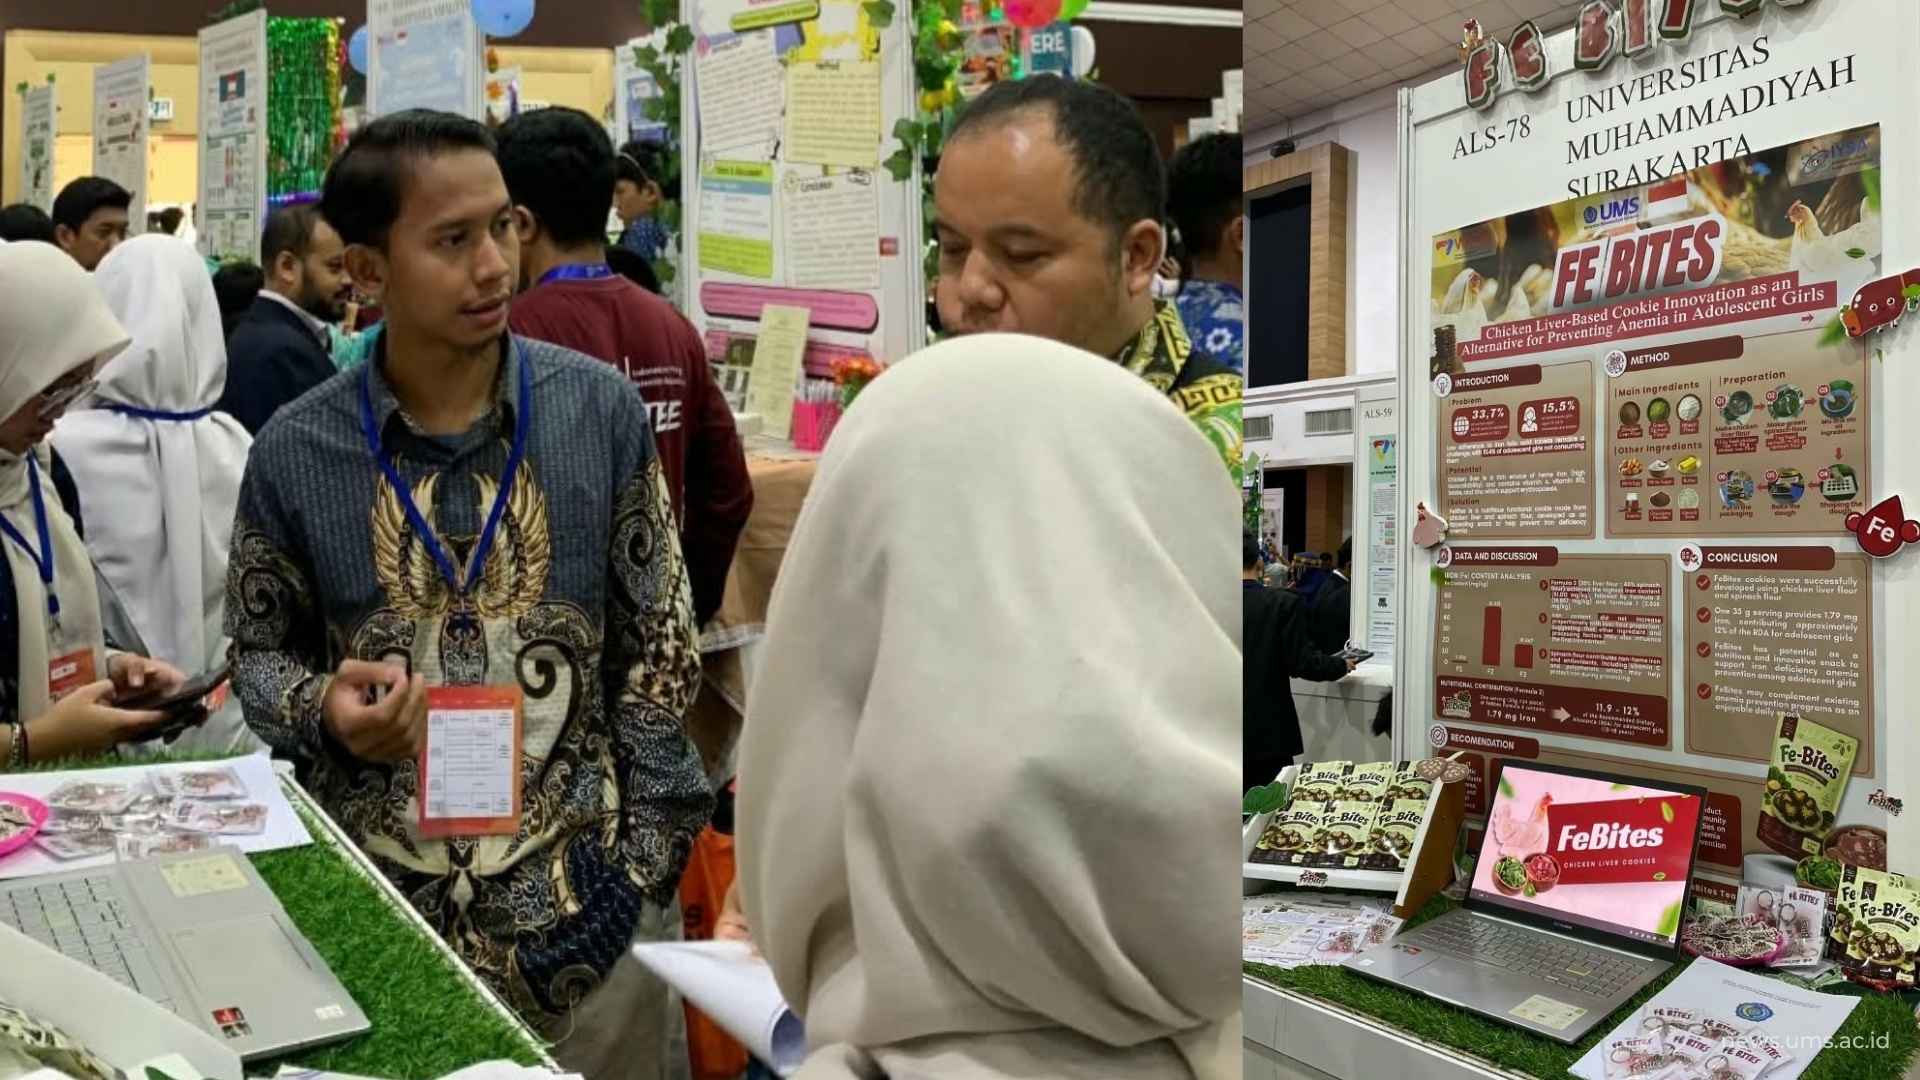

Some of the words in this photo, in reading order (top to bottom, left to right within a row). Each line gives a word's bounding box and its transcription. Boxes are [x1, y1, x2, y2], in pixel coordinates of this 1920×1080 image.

[1465, 20, 1549, 111] FE
[1567, 36, 1771, 123] UNIVERSITAS
[1568, 55, 1856, 165] MUHAMMADIYAH
[1452, 114, 1532, 161] ALS-78
[1568, 133, 1752, 199] SURAKARTA
[1600, 197, 1639, 220] UMS
[1554, 246, 1600, 309] FE
[1603, 220, 1721, 299] BITES
[1486, 326, 1532, 340] Chicken
[1536, 308, 1608, 333] Liver-Based
[1612, 300, 1659, 319] Cookie
[1664, 286, 1745, 311] Innovation
[1751, 283, 1767, 295] as
[1771, 279, 1791, 292] an
[1461, 337, 1523, 356] Alternative
[1526, 333, 1543, 346] for
[1547, 323, 1613, 344] Preventing
[1617, 314, 1669, 332] Anemia
[1673, 311, 1687, 323] in
[1692, 297, 1776, 320] Adolescent
[1782, 287, 1825, 305] Girls
[1631, 352, 1670, 366] METHOD
[1455, 373, 1510, 387] INTRODUCTION
[1723, 371, 1786, 385] Preparation
[1618, 387, 1640, 396] Main
[1452, 397, 1482, 406] Problem
[1618, 446, 1643, 454] Other
[1867, 516, 1895, 542] Fe
[1455, 552, 1473, 560] DATA
[1474, 552, 1489, 560] AND
[1491, 552, 1538, 561] DISCUSSION
[1707, 553, 1778, 564] CONCLUSION
[1471, 572, 1498, 580] CONTENT
[1714, 575, 1741, 583] FeBites
[1745, 576, 1775, 585] cookies
[1804, 577, 1858, 588] successfully
[1714, 585, 1754, 594] developed
[1757, 586, 1779, 594] using
[1781, 585, 1813, 594] chicken
[1816, 585, 1835, 594] liver
[1837, 586, 1858, 595] flour
[1714, 592, 1729, 600] and
[1731, 593, 1762, 602] spinach
[1763, 593, 1782, 601] flour
[1714, 607, 1730, 615] One
[1733, 607, 1742, 615] 35
[1745, 609, 1751, 618] g
[1753, 610, 1783, 619] serving
[1785, 611, 1822, 620] provides
[1843, 614, 1858, 623] mg
[1739, 619, 1788, 631] contributing
[1795, 621, 1859, 633] approximately
[1729, 627, 1738, 635] of
[1738, 628, 1752, 636] the
[1753, 629, 1770, 637] RDA
[1771, 630, 1783, 639] for
[1784, 631, 1833, 642] adolescent
[1833, 633, 1853, 644] girls
[1714, 642, 1742, 651] FeBites
[1753, 644, 1768, 653] has
[1779, 648, 1817, 658] potential
[1714, 652, 1751, 662] nutritious
[1754, 654, 1770, 662] and
[1773, 656, 1816, 666] innovative
[1820, 658, 1846, 667] snack
[1714, 661, 1744, 671] support
[1752, 662, 1767, 670] iron
[1774, 665, 1818, 676] deficiency
[1826, 669, 1858, 678] anemia
[1714, 669, 1756, 679] prevention
[1757, 672, 1786, 682] among
[1787, 674, 1835, 685] adolescent
[1836, 679, 1857, 688] girls
[1715, 695, 1744, 704] anemia
[1746, 698, 1789, 708] prevention
[1791, 702, 1832, 713] programs
[1746, 689, 1764, 699] may
[1768, 691, 1820, 702] complement
[1824, 695, 1859, 706] existing
[1487, 710, 1502, 718] 1.79
[1505, 712, 1517, 721] mg
[1596, 703, 1612, 712] 11.9
[1623, 706, 1640, 716] 12%
[1714, 703, 1753, 714] enjoyable
[1754, 707, 1775, 717] daily
[1450, 733, 1515, 750] RECOMENDATION
[1779, 744, 1839, 780] Fe-Bites
[1299, 771, 1340, 785] Fe-Bite
[1321, 811, 1370, 826] Fe-Bites
[1557, 822, 1664, 852] FeBites
[1564, 860, 1596, 870] CHICKEN
[1598, 859, 1619, 868] LIVER
[1622, 858, 1657, 866] COOKIES
[1667, 1009, 1692, 1021] BITES
[1686, 1037, 1711, 1053] BITES
[1735, 1050, 1762, 1065] BITES
